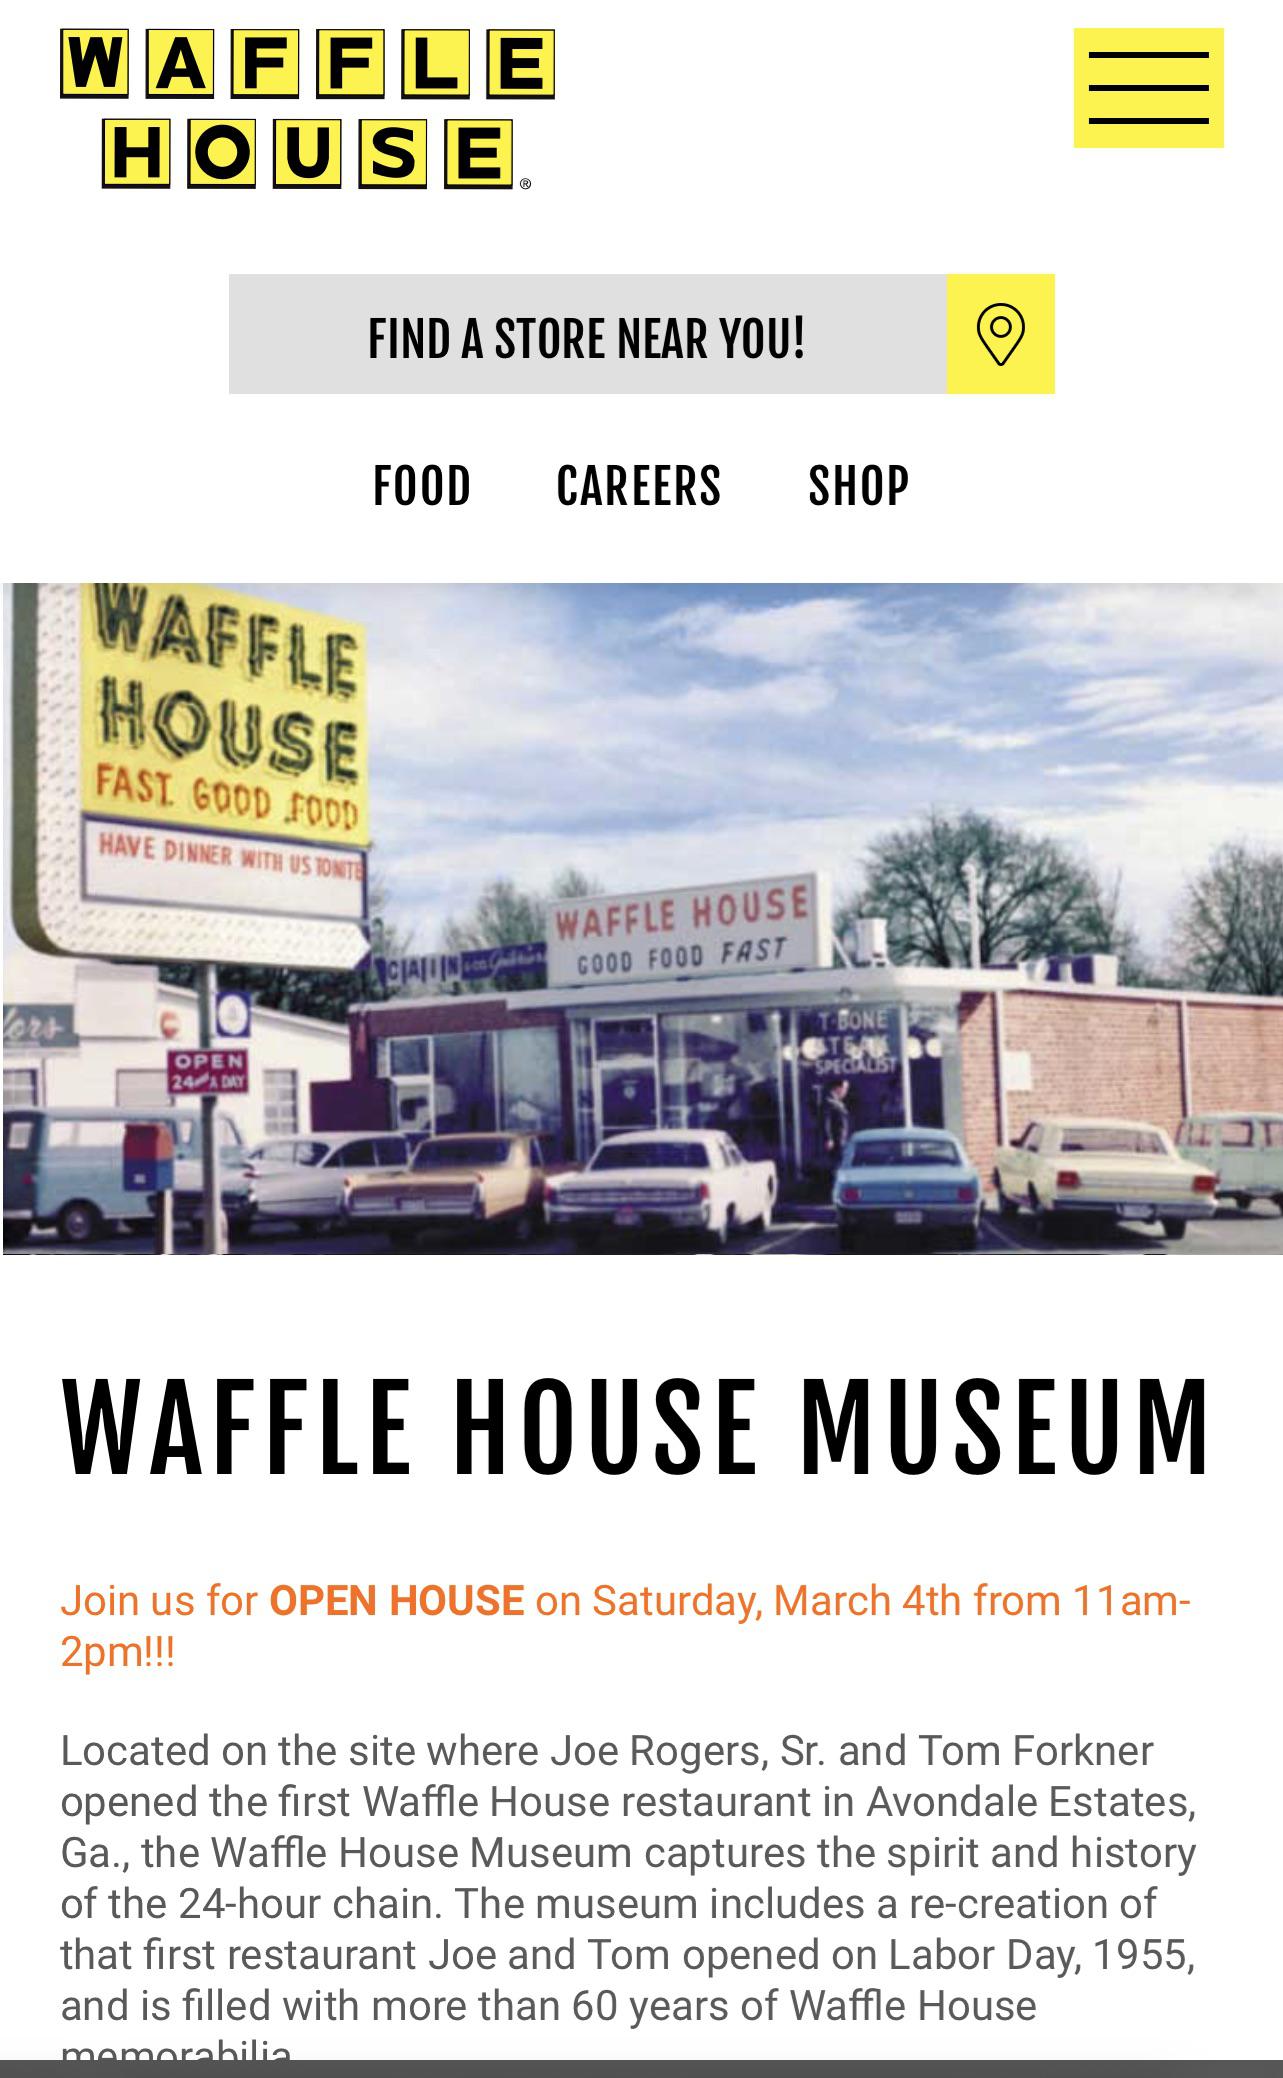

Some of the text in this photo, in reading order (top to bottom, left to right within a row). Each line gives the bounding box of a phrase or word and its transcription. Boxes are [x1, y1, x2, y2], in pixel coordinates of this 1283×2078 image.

[68, 37, 543, 89] WAFFLE
[114, 124, 501, 179] HOUSE
[370, 316, 803, 358] FIND A STORE NEAR YOU!
[375, 465, 469, 505] FOOD
[558, 465, 720, 505] CAREERS
[810, 465, 908, 505] SHOP
[95, 583, 358, 698] WAFFLE
[99, 675, 358, 785] HOUSE
[96, 762, 359, 831] FAST GOOD FOOD
[99, 832, 155, 860] HAVE
[163, 839, 232, 866] DINNER
[241, 847, 284, 873] WITH
[290, 855, 312, 876] US
[556, 884, 808, 940] WAFFLE HOUSE
[578, 936, 787, 976] GOOD FOOD FAST
[171, 1074, 194, 1090] 24
[221, 1075, 244, 1089] DAY
[175, 1054, 243, 1070] OPEN
[815, 1057, 898, 1076] SPECIALIST
[62, 1378, 1204, 1475] WAFFLE HOUSE MUSEUM
[61, 1583, 1190, 1624] Join us for OPEN HOUSE on Saturday, March 4th from 11am-
[62, 1636, 173, 1675] 2pm!!!
[63, 1733, 1154, 1774] Located on the site where Joe Rogers, Sr. and Tom Forkner
[62, 1784, 1194, 1825] opened the first Waffle House restaurant in Avondale Estates,
[62, 1835, 1196, 1876] Ga., the Waffle House Museum captures the spirit and history
[62, 1886, 1158, 1919] of the 24-hour chain. The museum includes a re-creation of
[60, 1937, 1193, 1978] that first restaurant Joe and Tom opened on Labor Day, 1955,
[62, 1988, 1036, 2029] and is filled with more than 60 years of Waffle House
